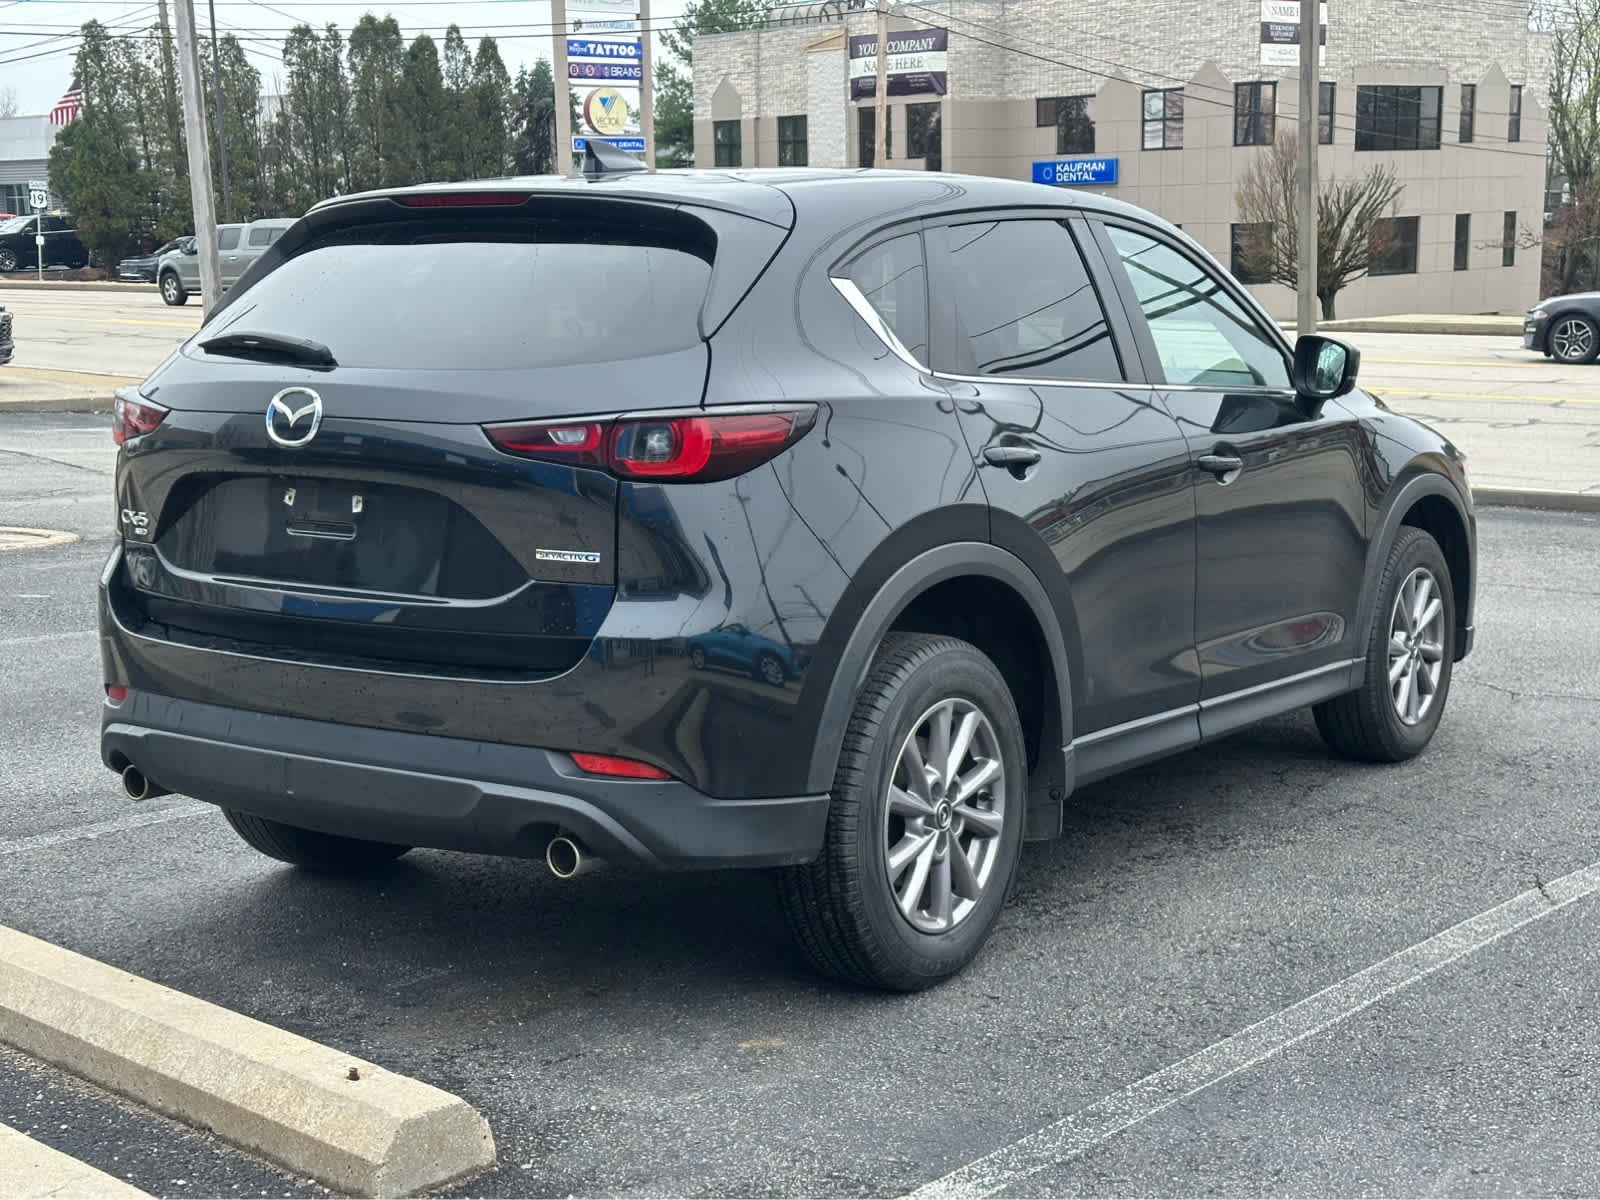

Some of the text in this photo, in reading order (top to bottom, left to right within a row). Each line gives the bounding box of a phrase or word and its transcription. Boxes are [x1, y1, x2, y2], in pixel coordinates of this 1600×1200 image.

[587, 43, 636, 56] TATTOO
[859, 38, 936, 56] YOU COMPANY
[863, 56, 924, 73] NAE HERE
[610, 66, 642, 78] BRAINS
[1056, 161, 1105, 173] KAUFMAN
[1056, 171, 1095, 182] DENTAL
[32, 193, 44, 204] 19
